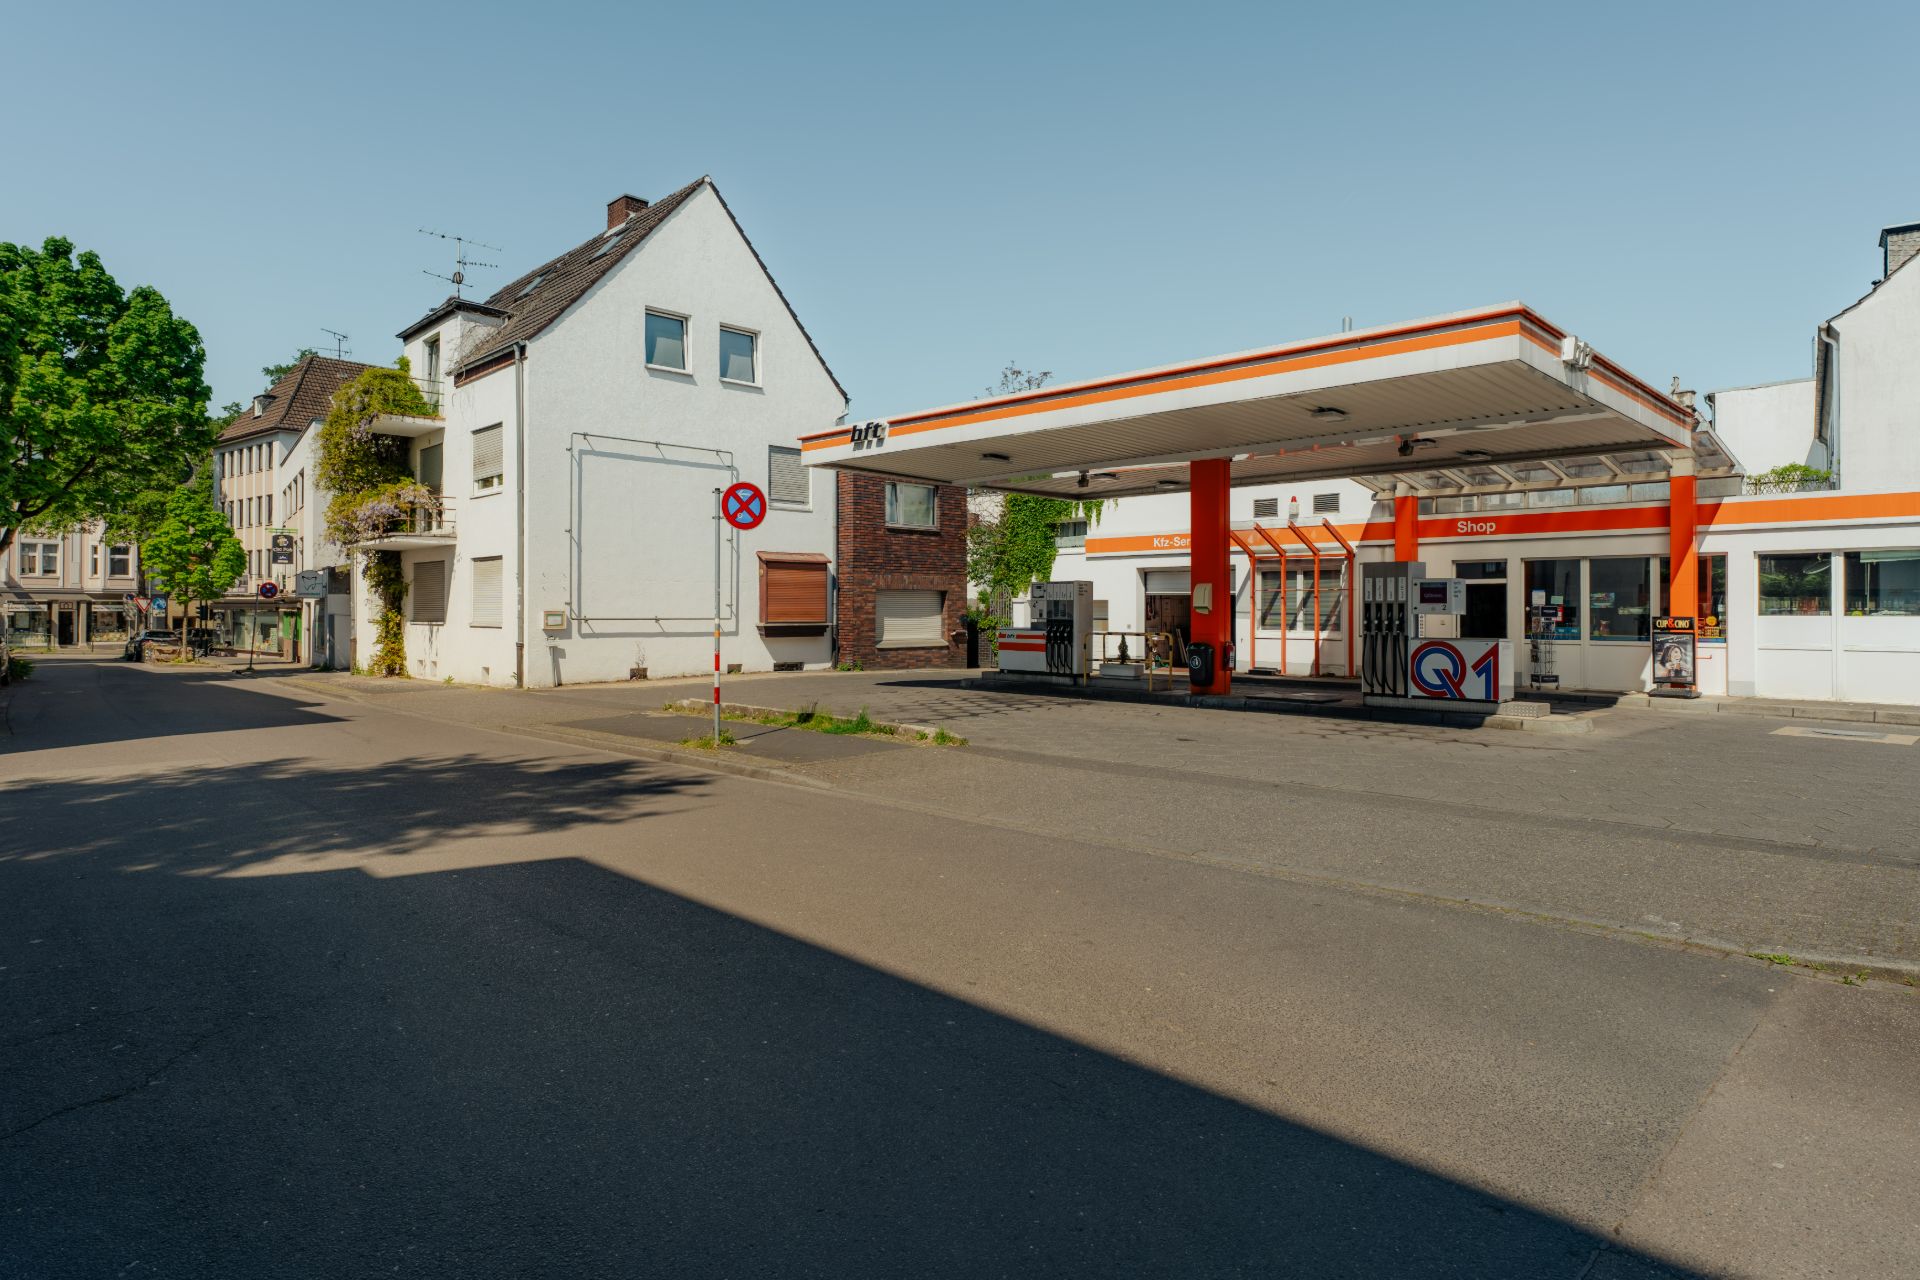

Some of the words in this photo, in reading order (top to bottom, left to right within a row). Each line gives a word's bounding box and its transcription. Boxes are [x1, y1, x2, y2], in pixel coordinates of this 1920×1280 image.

[850, 421, 882, 442] bft
[1457, 520, 1496, 534] Shop
[1656, 617, 1690, 629] CUP&CINO
[1410, 640, 1499, 701] Q1
